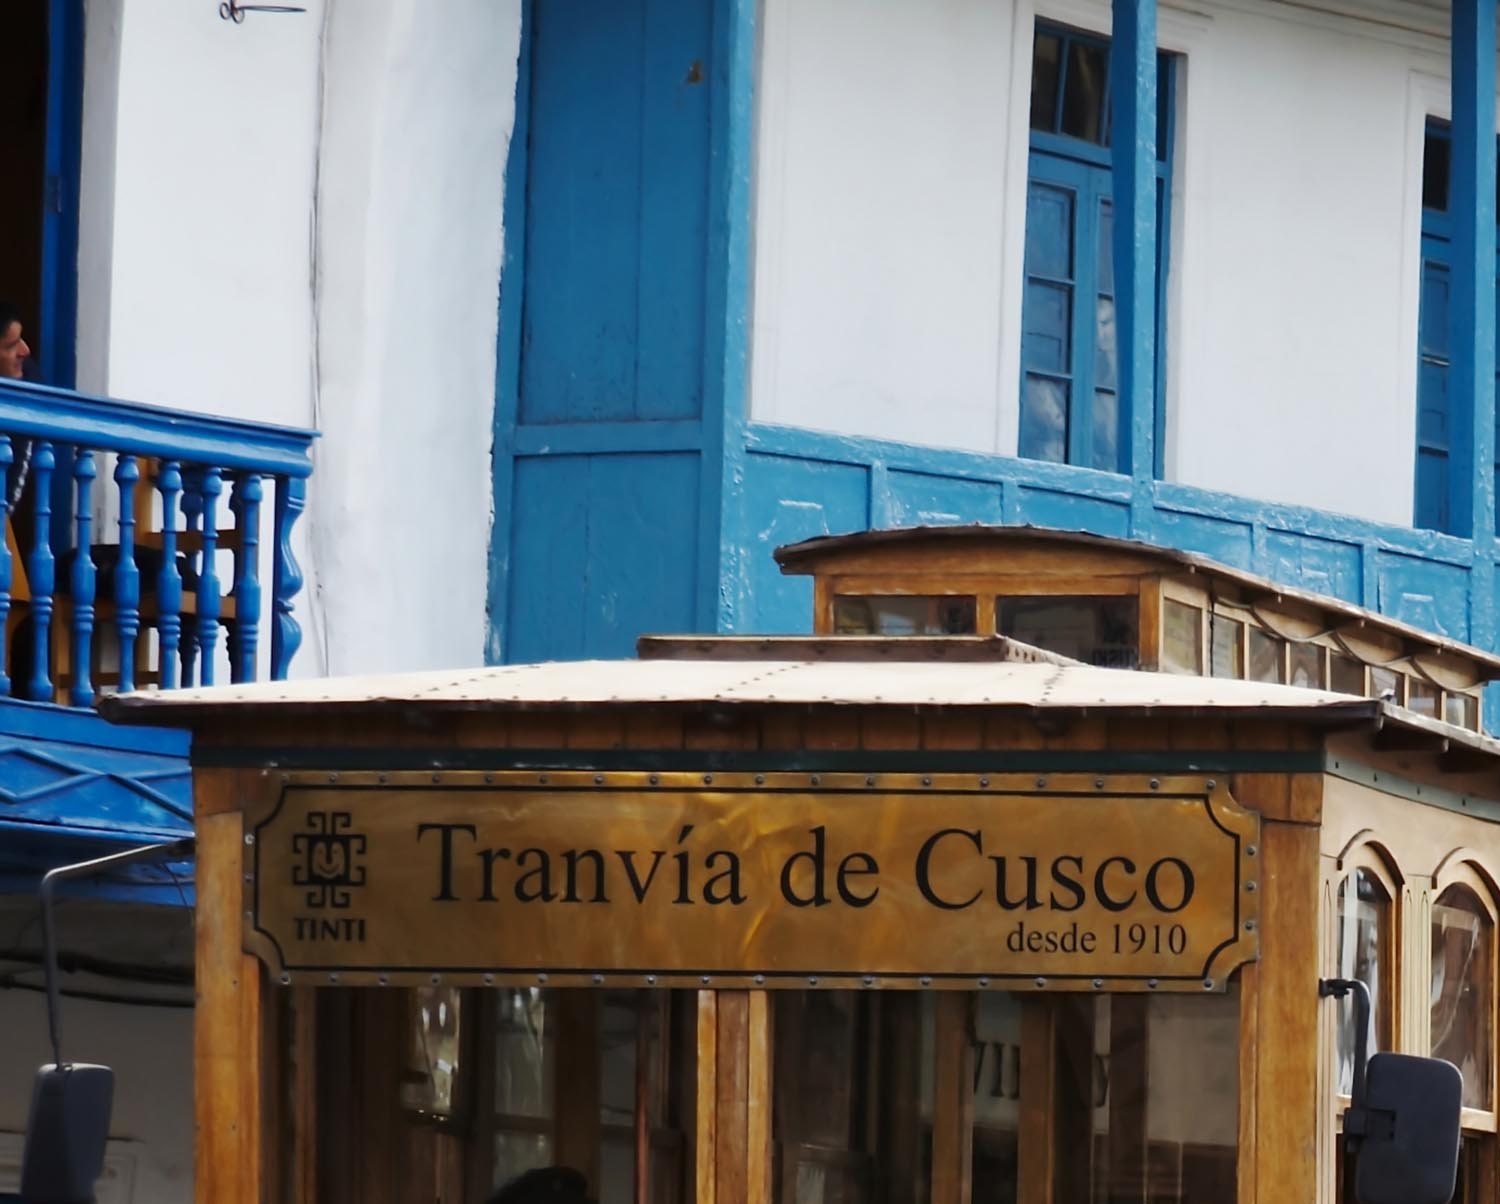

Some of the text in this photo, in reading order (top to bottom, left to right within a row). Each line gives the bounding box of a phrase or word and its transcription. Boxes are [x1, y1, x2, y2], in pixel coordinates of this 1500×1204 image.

[416, 823, 1196, 914] Tranvía de Cusco
[293, 917, 366, 942] TINTI
[1006, 920, 1187, 955] desde 1910
